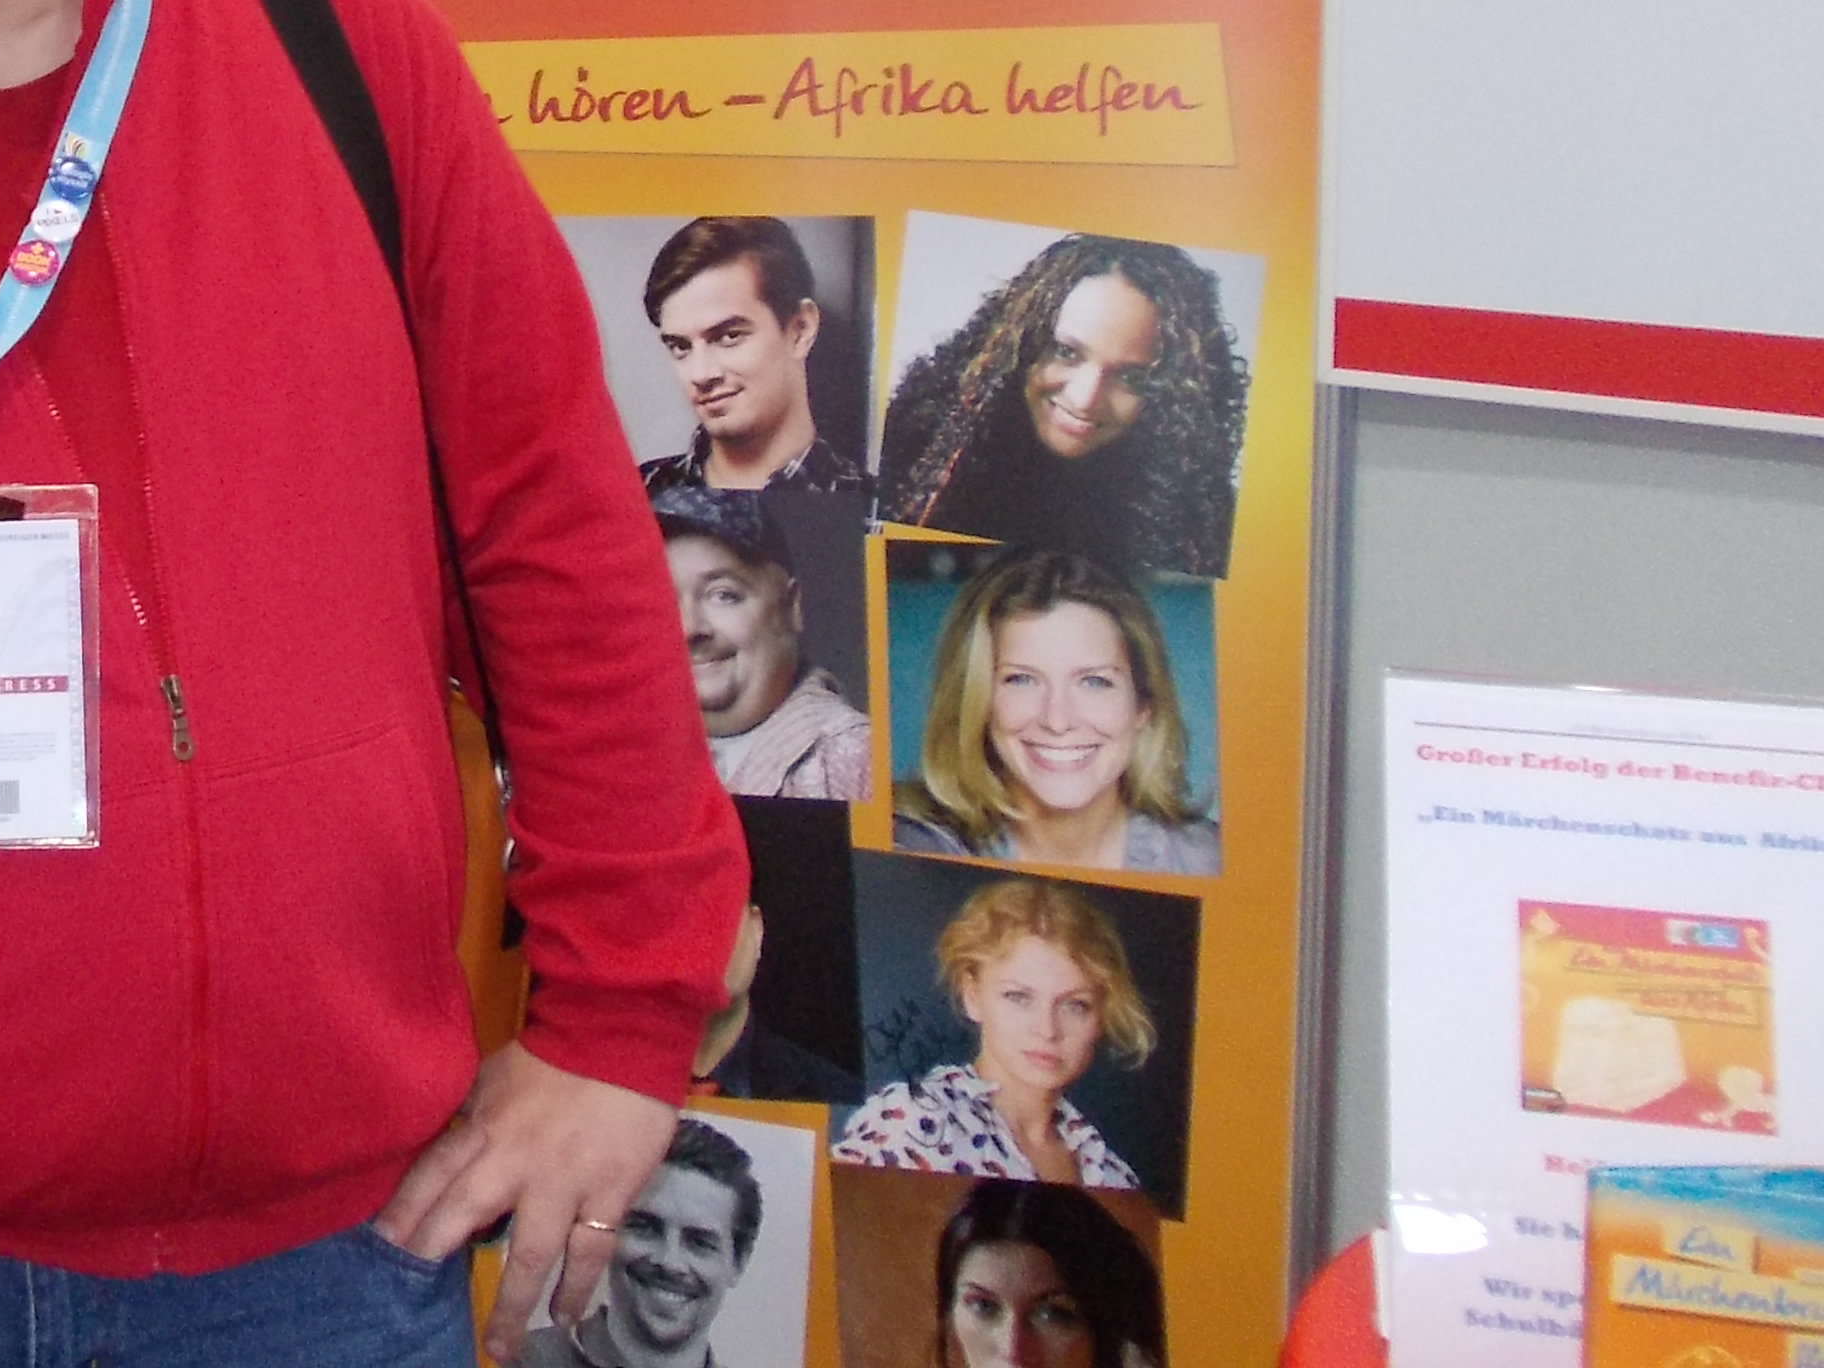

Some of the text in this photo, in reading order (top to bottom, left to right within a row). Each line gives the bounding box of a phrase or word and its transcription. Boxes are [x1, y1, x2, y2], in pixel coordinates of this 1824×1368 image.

[529, 66, 712, 124] hören
[1005, 62, 1203, 136] helfen
[1521, 752, 1610, 780] Erfolg
[1616, 760, 1667, 781] der
